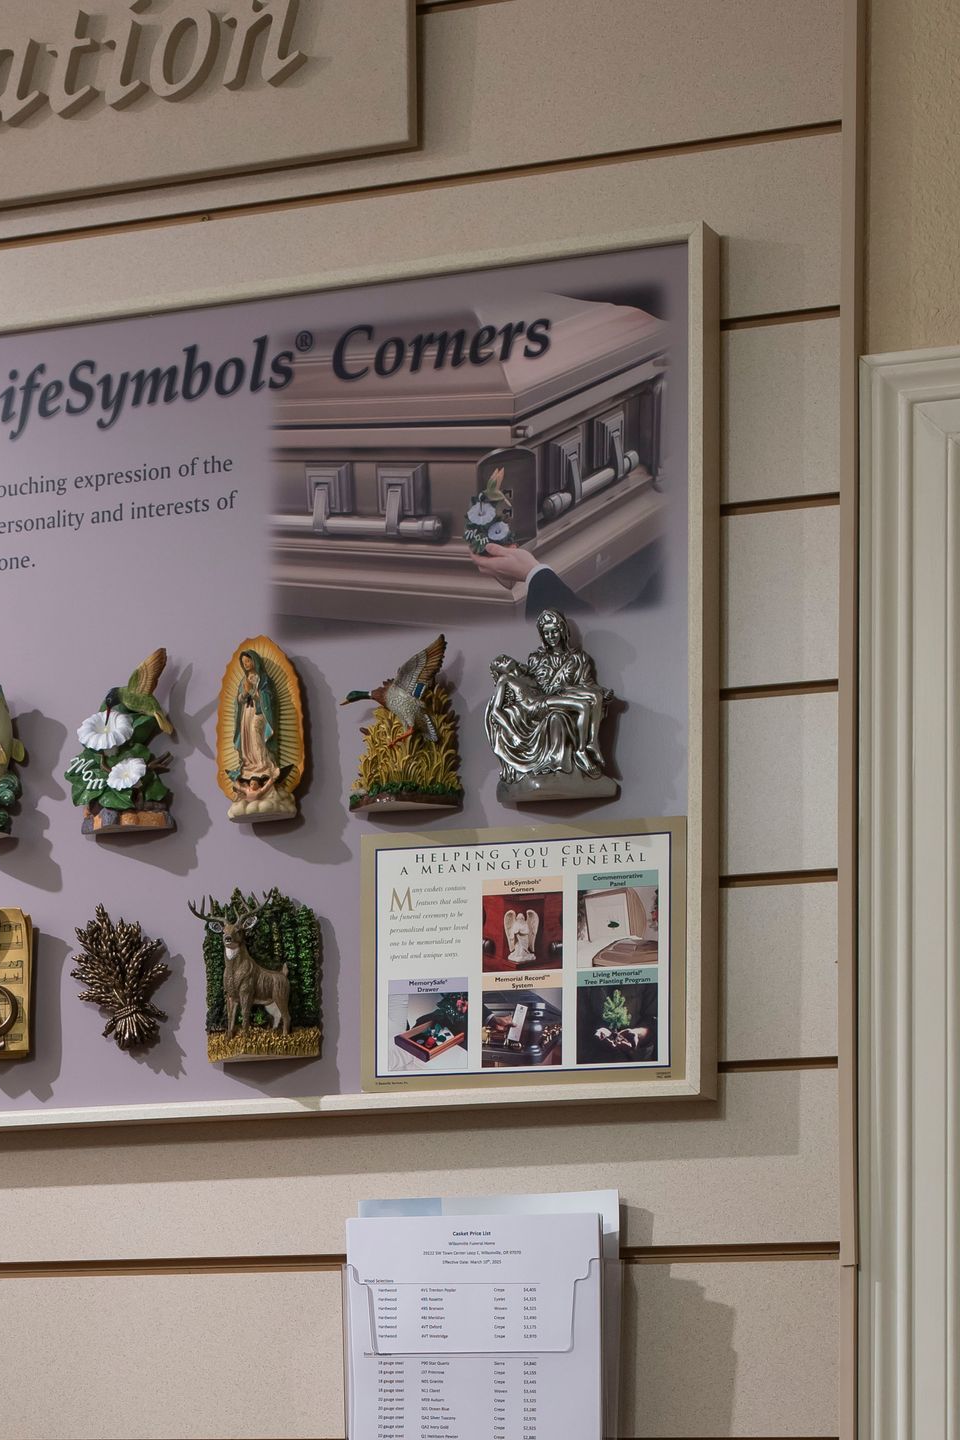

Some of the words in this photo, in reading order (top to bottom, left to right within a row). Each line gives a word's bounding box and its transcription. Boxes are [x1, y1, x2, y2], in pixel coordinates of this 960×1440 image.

[332, 317, 552, 382] Corners
[74, 463, 171, 491] expression
[178, 457, 200, 477] of
[203, 455, 233, 474] the
[91, 503, 123, 524] and
[131, 498, 210, 520] interests
[217, 490, 238, 511] of
[67, 757, 104, 790] Mom
[400, 866, 409, 876] A
[421, 859, 549, 875] MEANINGFUL
[561, 852, 646, 867] FUNERAL
[415, 849, 499, 864] HELPING
[512, 846, 549, 858] YOU
[561, 841, 633, 856] CREATE
[592, 873, 643, 881] Commemorative
